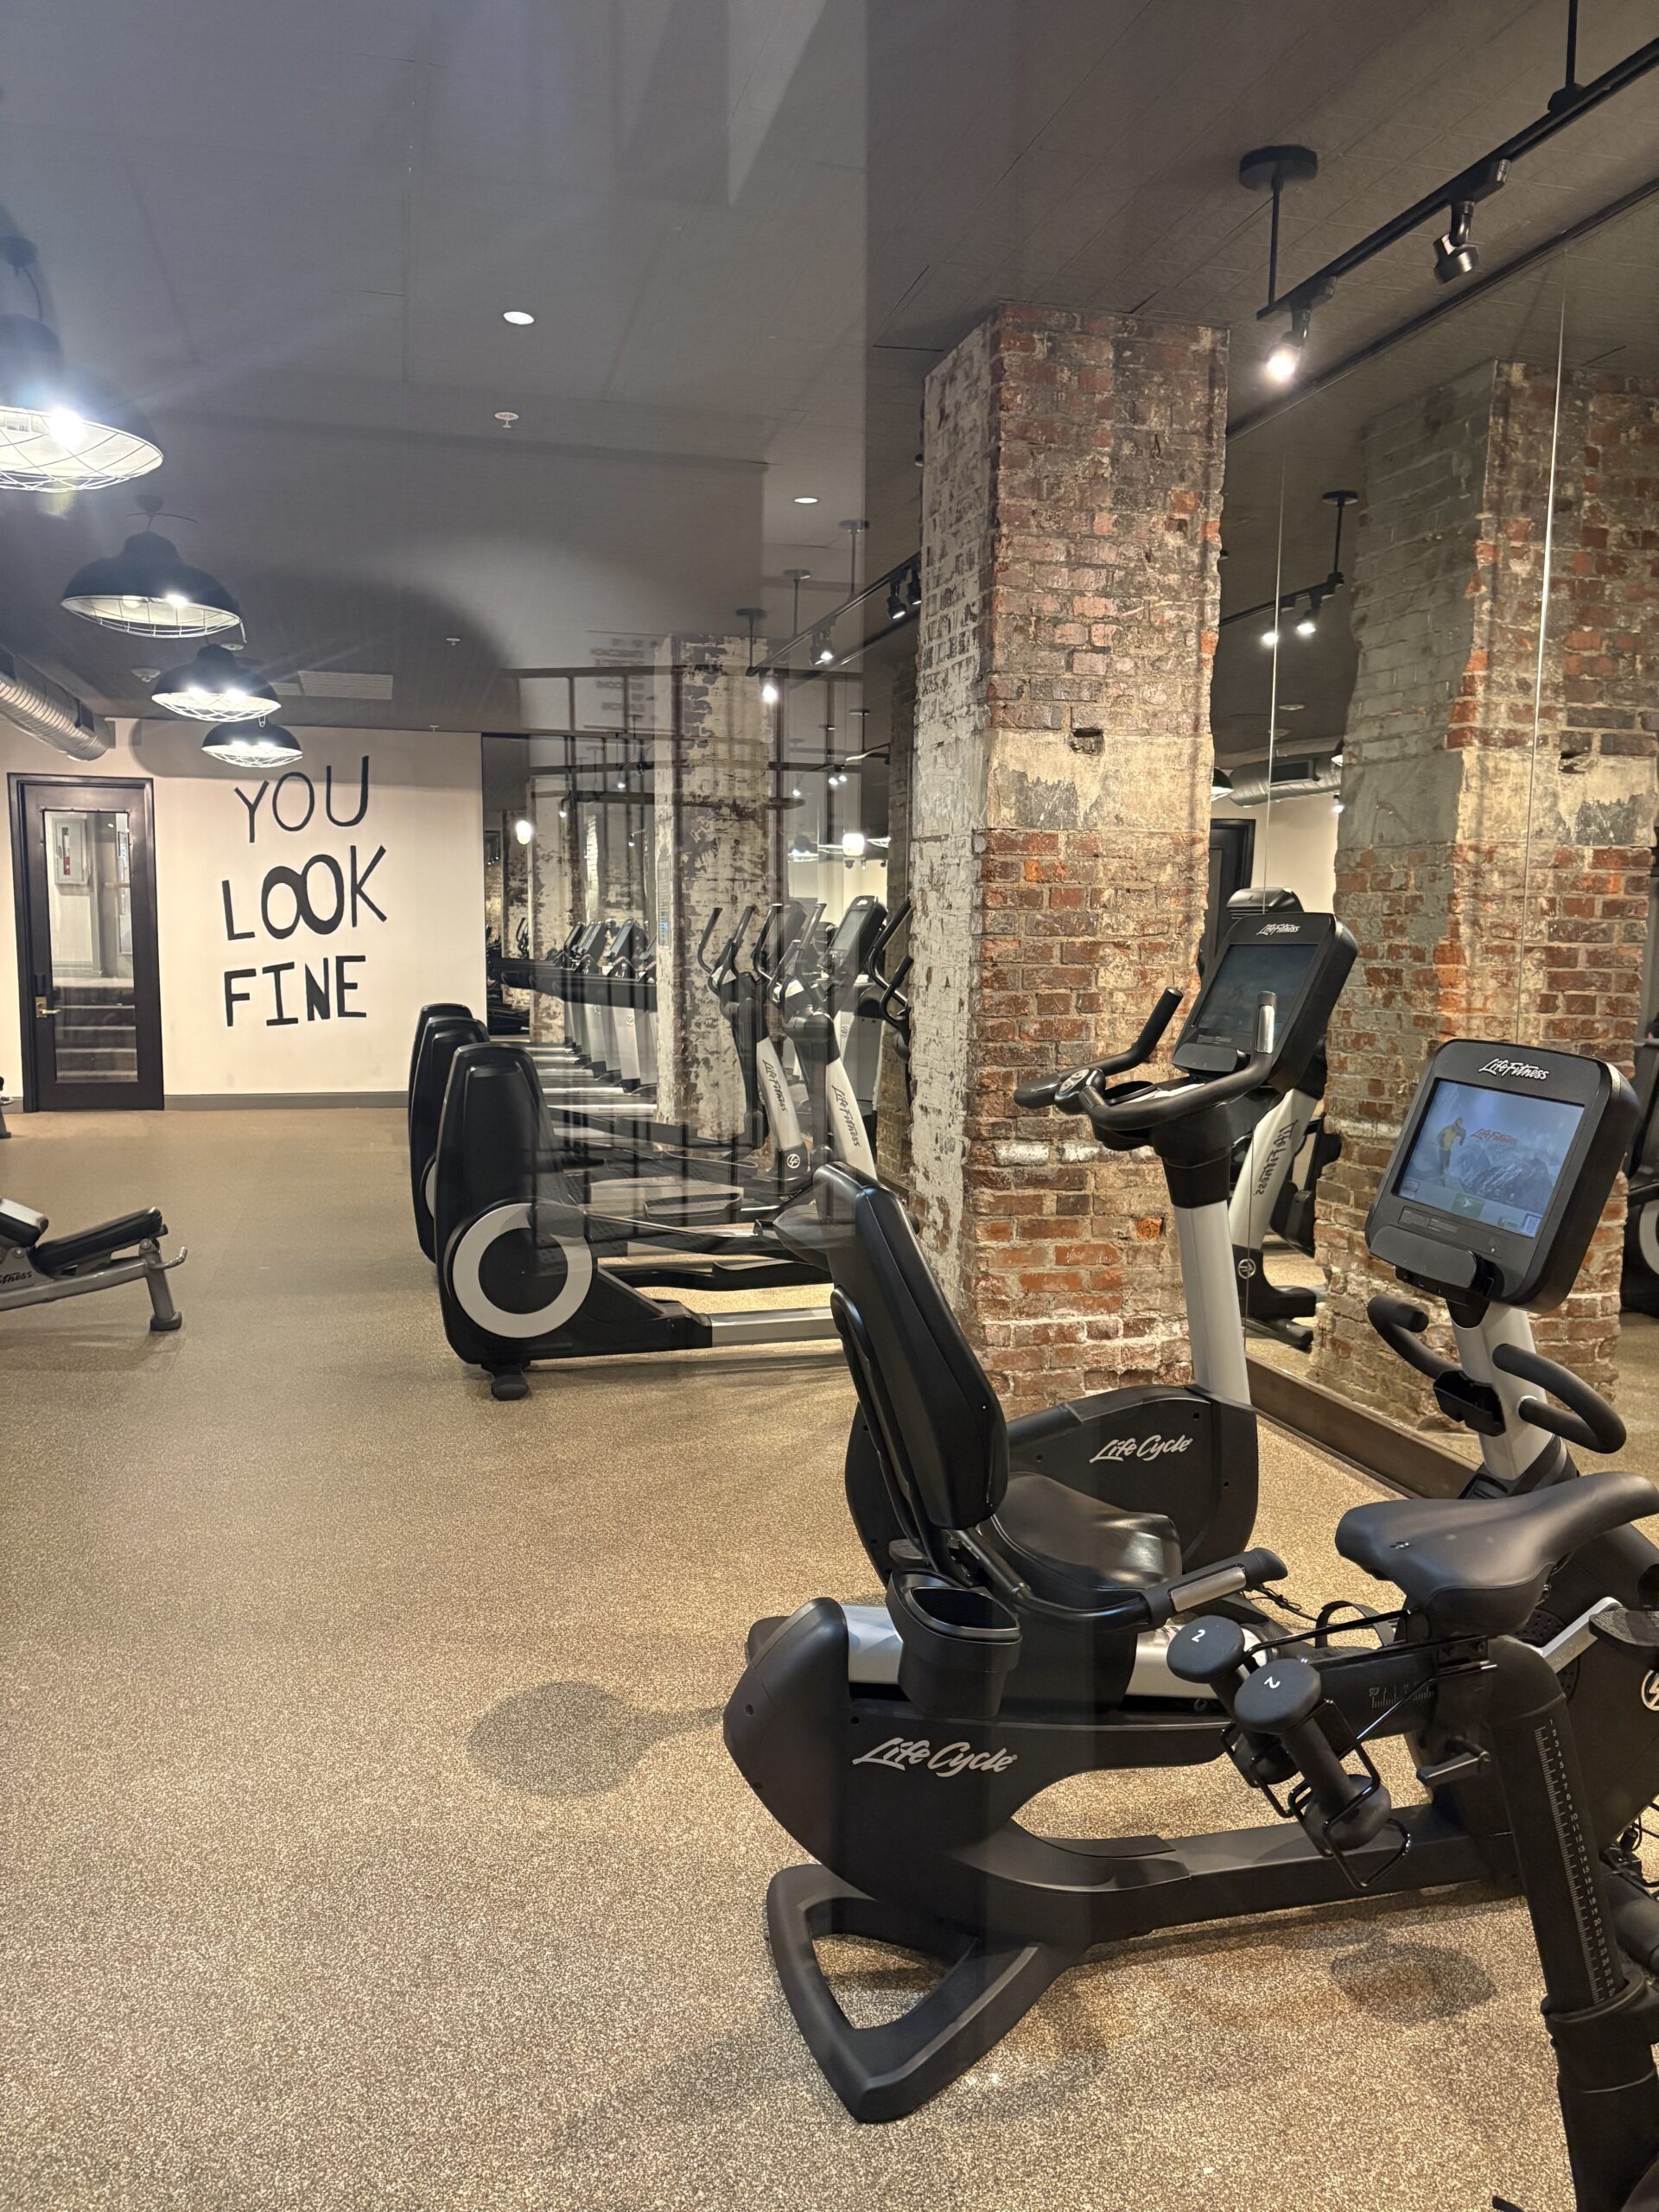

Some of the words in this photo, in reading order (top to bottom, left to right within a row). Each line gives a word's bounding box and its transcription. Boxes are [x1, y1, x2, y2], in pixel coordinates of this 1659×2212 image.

[234, 755, 369, 843] YOU
[221, 844, 387, 941] LOOK
[224, 955, 367, 1027] FINE
[1089, 1437, 1138, 1464] Life
[1191, 1629, 1206, 1643] 2
[1264, 1675, 1281, 1689] 2
[852, 1737, 931, 1771] Life
[1570, 1813, 1579, 1821] 10
[1578, 1845, 1586, 1853] 13
